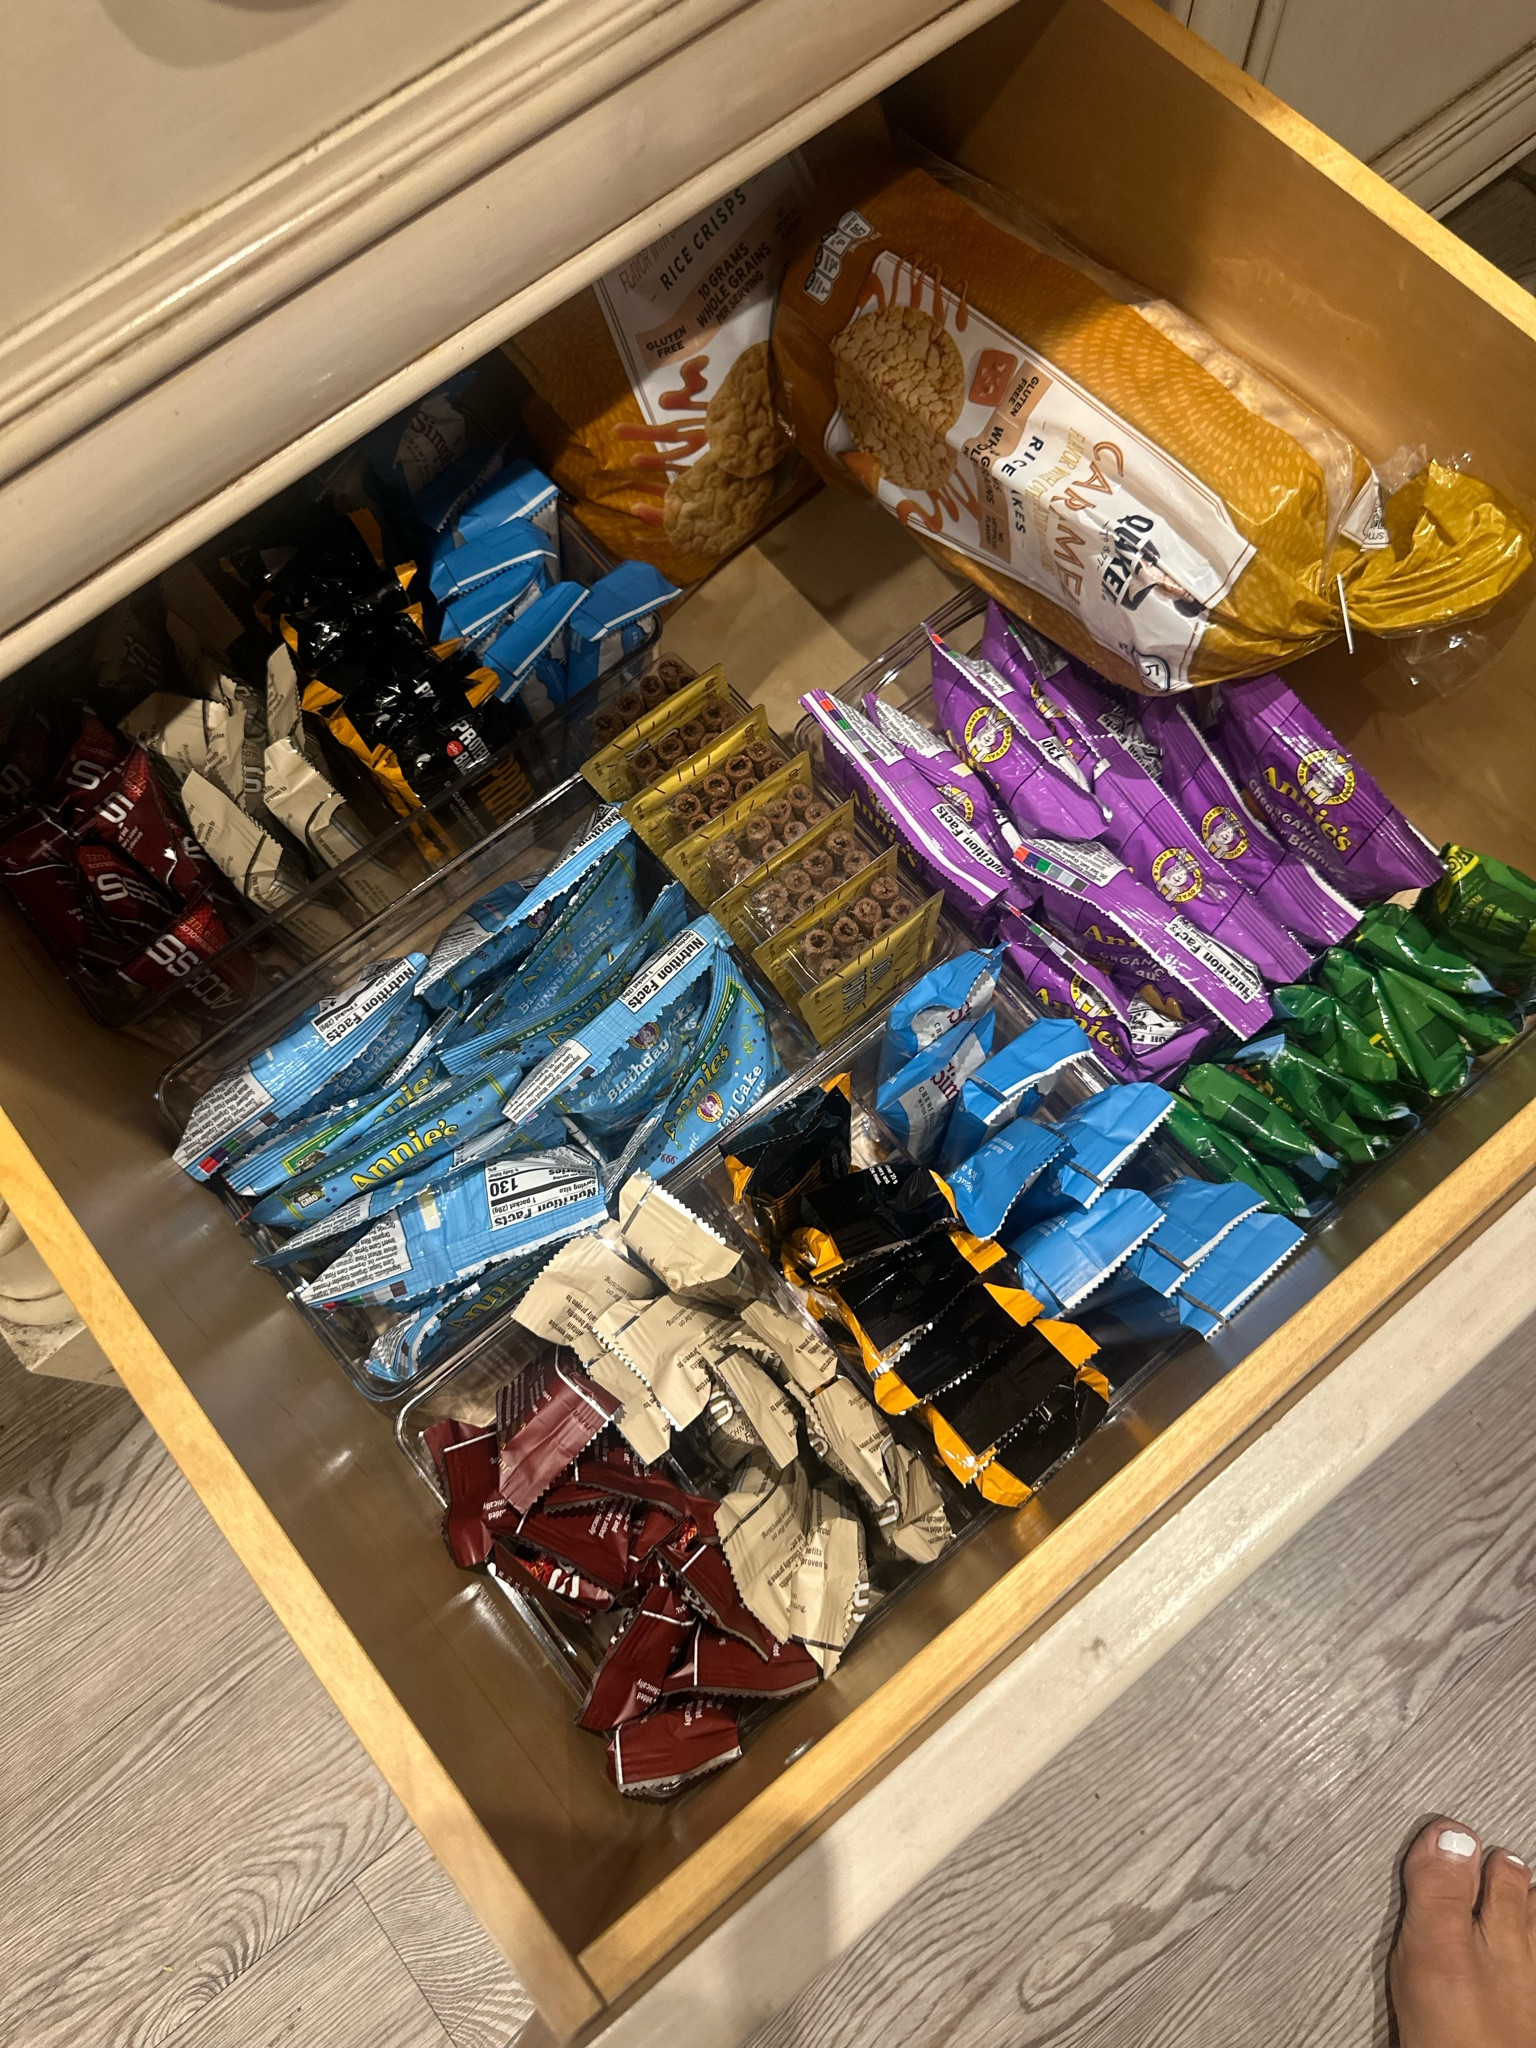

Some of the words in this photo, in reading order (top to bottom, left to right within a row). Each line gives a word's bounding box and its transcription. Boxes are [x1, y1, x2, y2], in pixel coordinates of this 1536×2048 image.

[660, 246, 693, 290] RICE
[693, 188, 746, 250] CRISPS
[618, 248, 653, 293] FLAVOR
[695, 286, 730, 328] WHOLE
[728, 241, 772, 288] GRAINS
[698, 284, 709, 300] 10
[708, 242, 749, 287] GRAMS
[730, 271, 764, 305] SERVING
[646, 325, 687, 351] GLUTEN
[657, 341, 684, 358] FREE
[1008, 378, 1027, 405] FREE
[1010, 377, 1039, 417] GLUTEN
[1001, 436, 1044, 477] RICE
[936, 804, 967, 837] Facts
[1262, 765, 1353, 853] Annie's
[962, 834, 1006, 878] Nutrition
[1170, 921, 1201, 952] Facts
[656, 936, 703, 981] Nutrition
[1202, 950, 1257, 1003] Nutrition
[361, 967, 415, 1014] Nutrition
[627, 979, 659, 1011] Facts
[632, 973, 650, 990] packet
[326, 1012, 362, 1044] Facts
[607, 1040, 671, 1103] Birthday
[731, 1065, 764, 1105] Cake
[663, 1042, 730, 1140] Annie's
[351, 1119, 459, 1191] Annie's
[489, 1177, 519, 1197] 130
[509, 1198, 531, 1210] packet
[537, 1187, 598, 1213] Nutrition
[559, 1186, 573, 1194] size
[492, 1205, 509, 1215] (28g)
[494, 1208, 533, 1227] Facts
